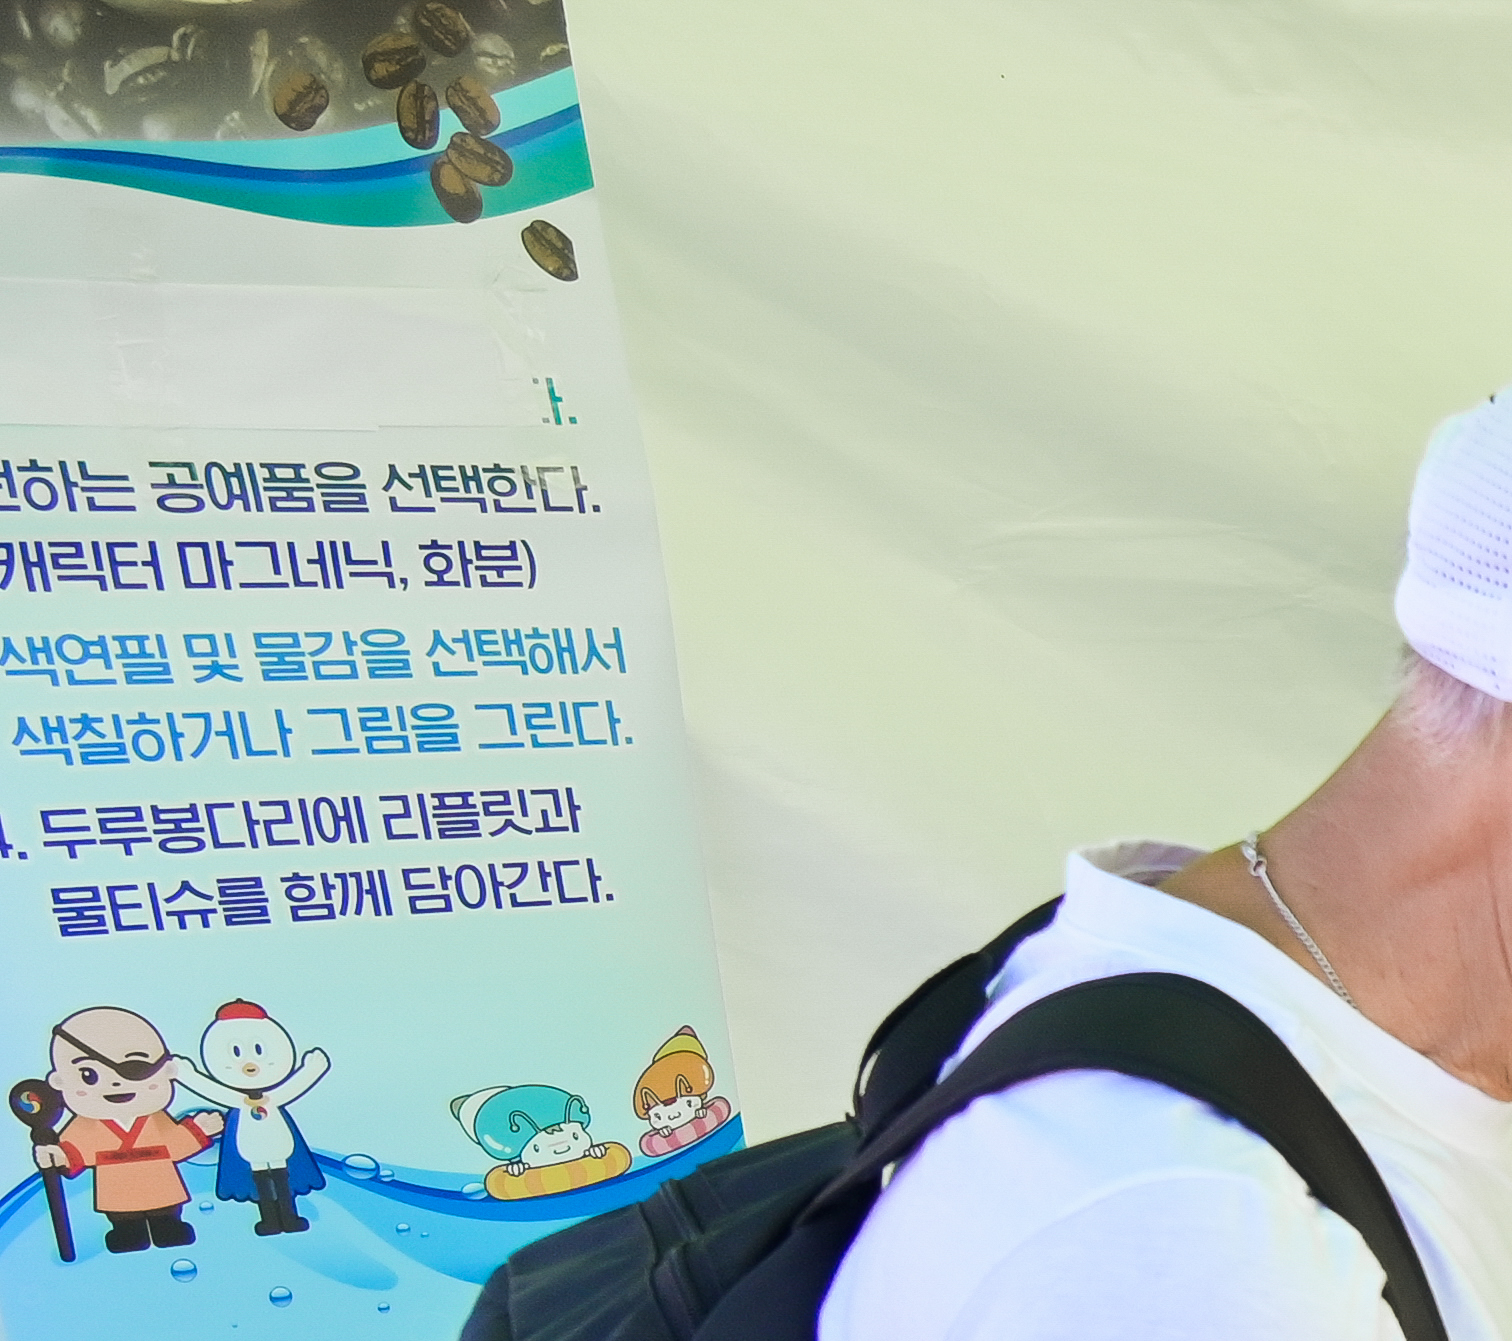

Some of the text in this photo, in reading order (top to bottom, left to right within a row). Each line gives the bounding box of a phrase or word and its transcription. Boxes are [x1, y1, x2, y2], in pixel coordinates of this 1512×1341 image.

[148, 461, 370, 513] 공예품을
[382, 463, 601, 513] 선택한다.
[177, 540, 409, 591] 마그네닉,
[418, 539, 537, 589] 화분)
[1, 627, 627, 687] 색연필 및 물감을 선택해서
[12, 700, 634, 766] 색칠하거나 그림을 그린다.
[40, 796, 369, 859] 두루봉다리에
[379, 787, 581, 840] 리플릿과
[51, 858, 615, 937] 물티슈를 함께 담아간다.
